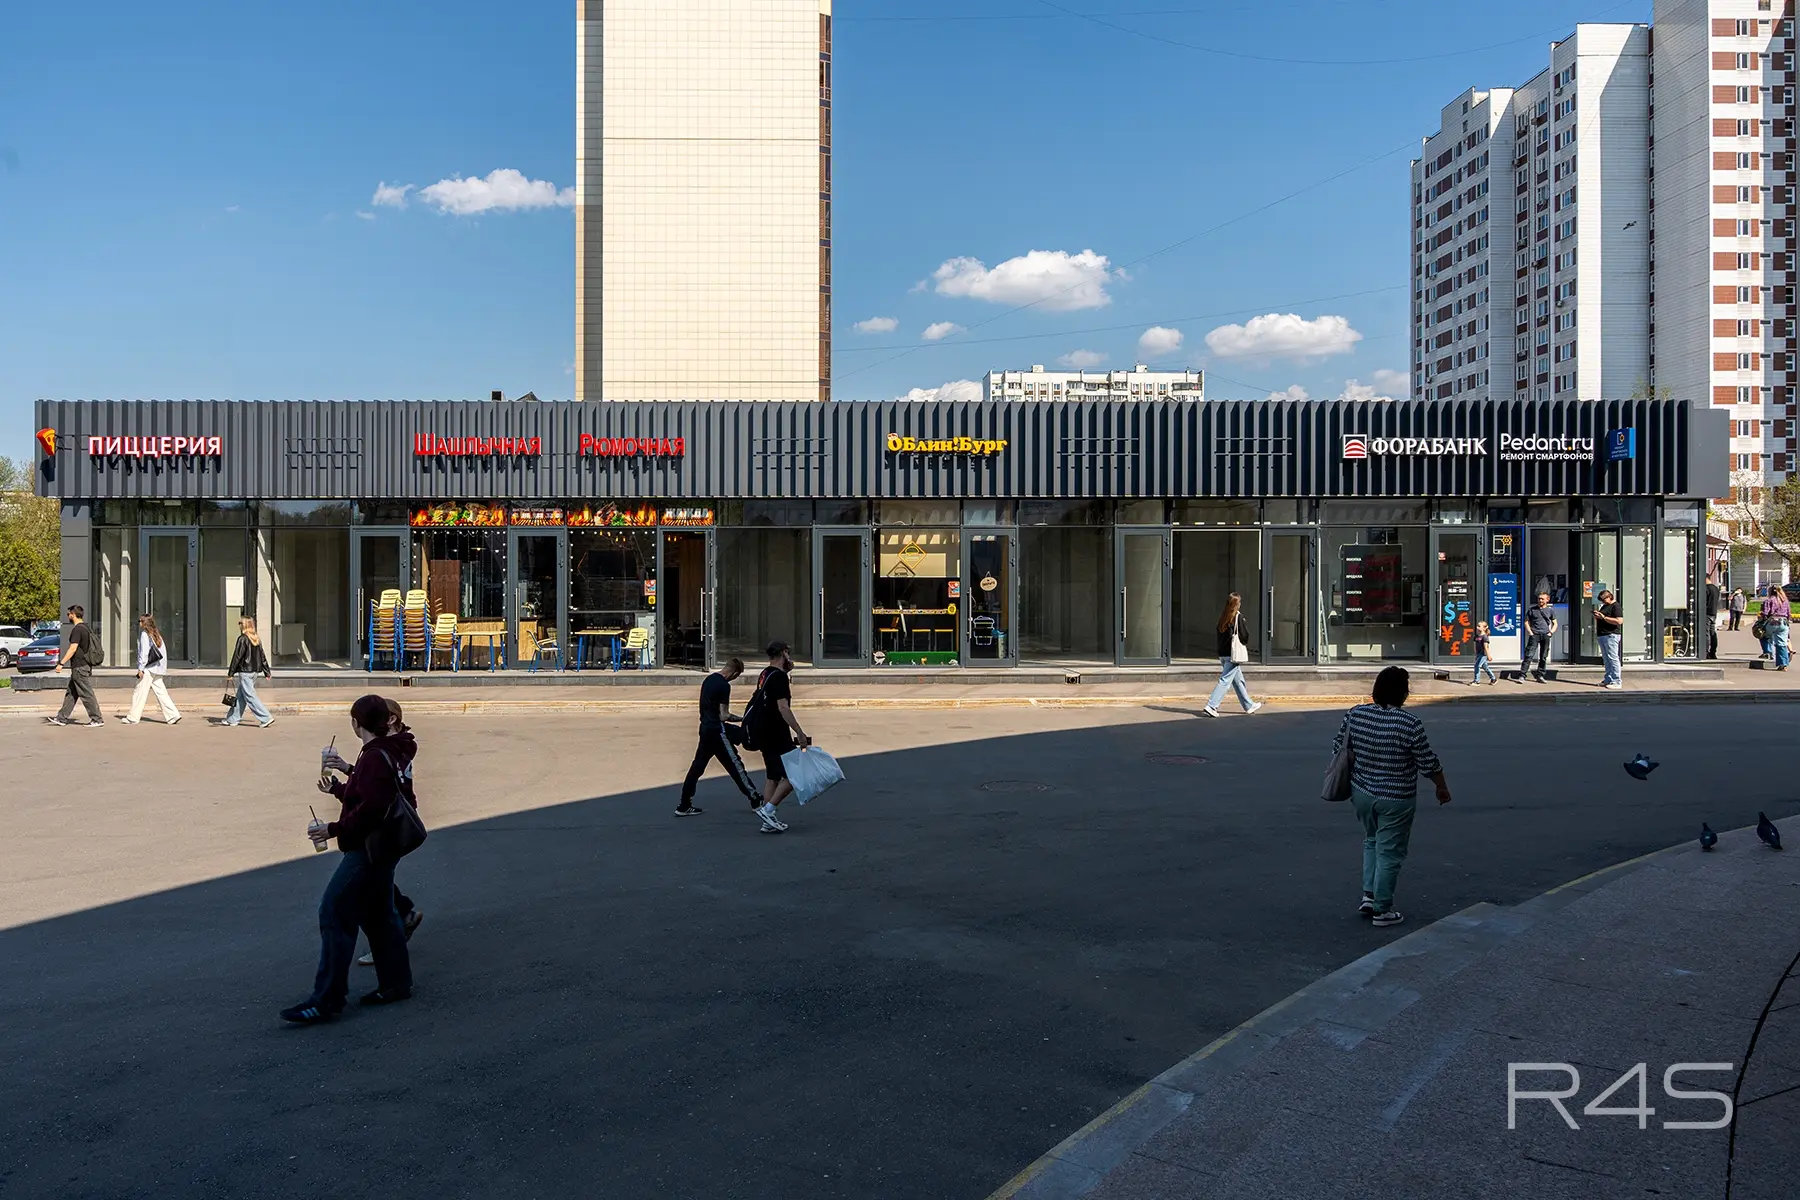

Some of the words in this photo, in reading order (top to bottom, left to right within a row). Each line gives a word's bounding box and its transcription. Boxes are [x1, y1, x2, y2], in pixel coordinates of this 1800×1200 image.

[88, 436, 222, 458] ПИЦЦЕРИЯ
[414, 433, 542, 456] ШАШЛЫЧНАЯ
[579, 433, 685, 457] РЮМОЧНАЯ
[1372, 437, 1488, 456] ФОРАБАНК
[1500, 433, 1594, 451] Pedant.ru
